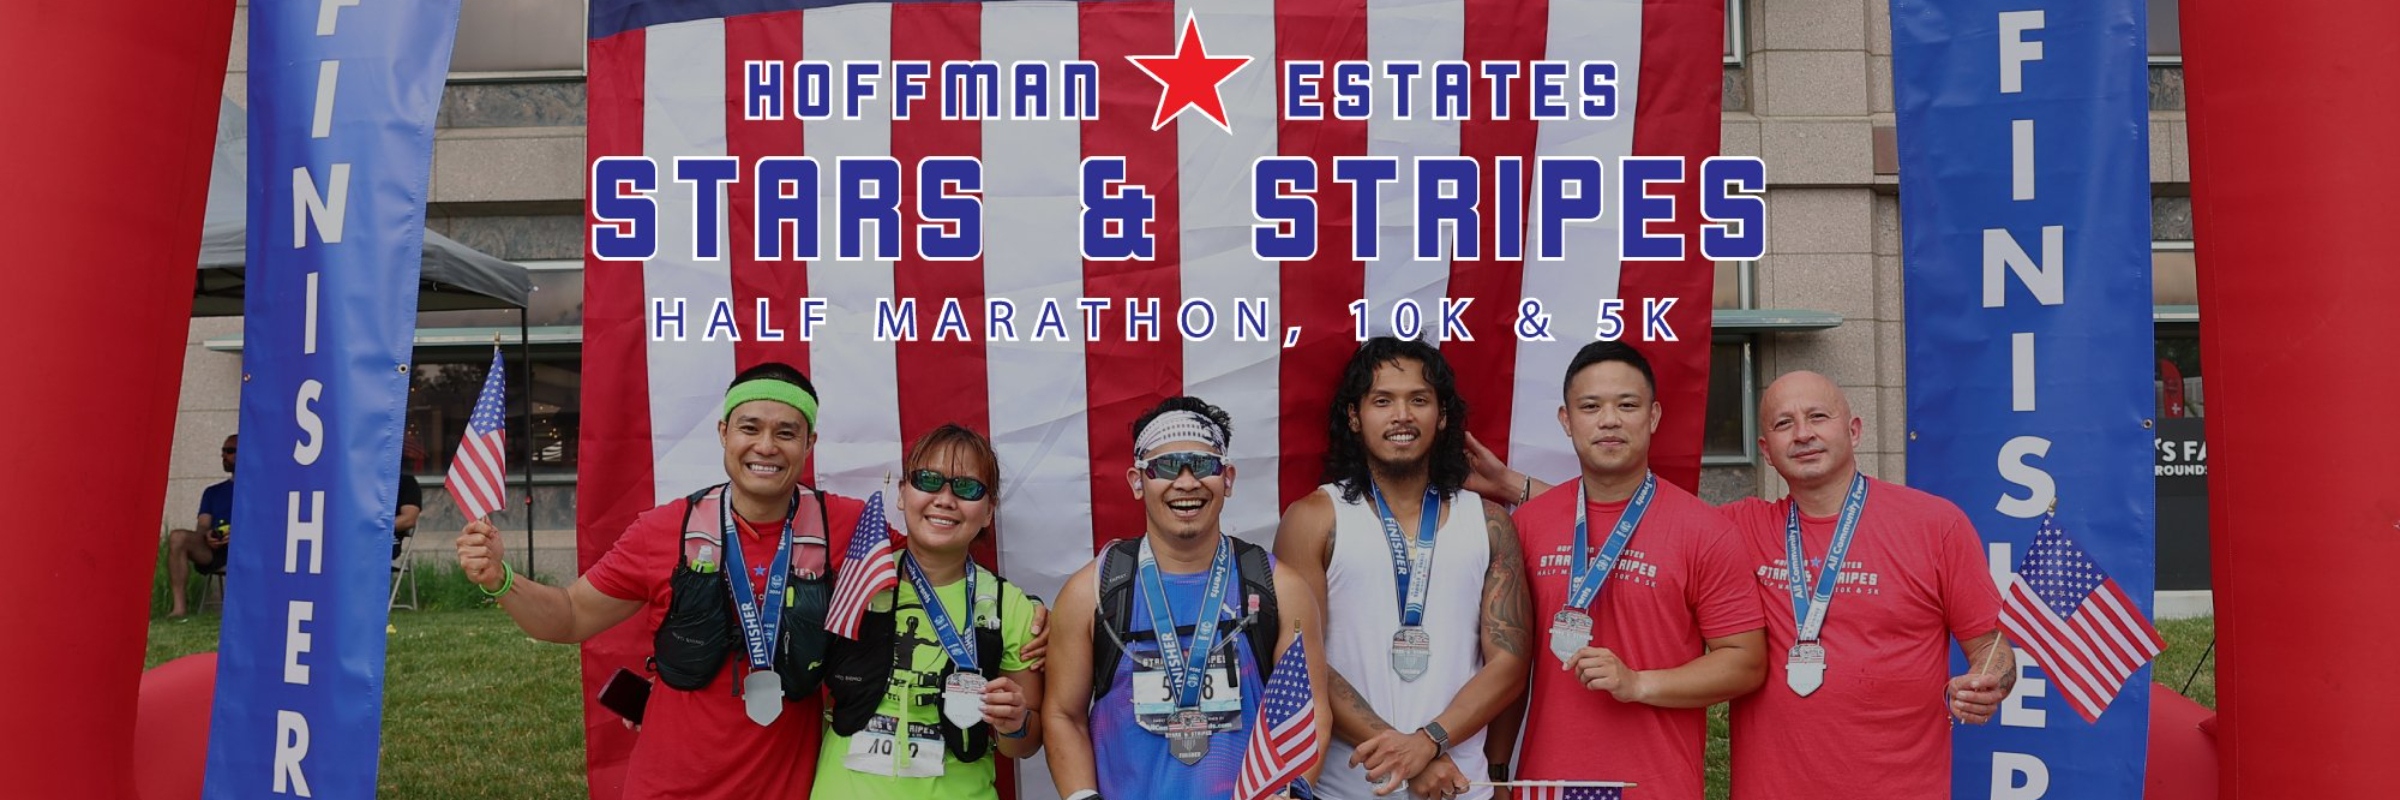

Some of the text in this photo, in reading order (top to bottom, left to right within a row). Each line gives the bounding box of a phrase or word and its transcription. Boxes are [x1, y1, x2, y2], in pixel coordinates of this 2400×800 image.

[2155, 465, 2207, 476] ROUND
[1832, 500, 1860, 554] Community
[1384, 517, 1407, 575] FINISHER
[1540, 555, 1572, 567] STAR
[1827, 555, 1839, 571] All
[1210, 566, 1226, 598] Events
[1757, 565, 1788, 580] STAR
[915, 578, 931, 604] Events
[1793, 585, 1804, 599] All
[741, 601, 766, 666] FINISHER
